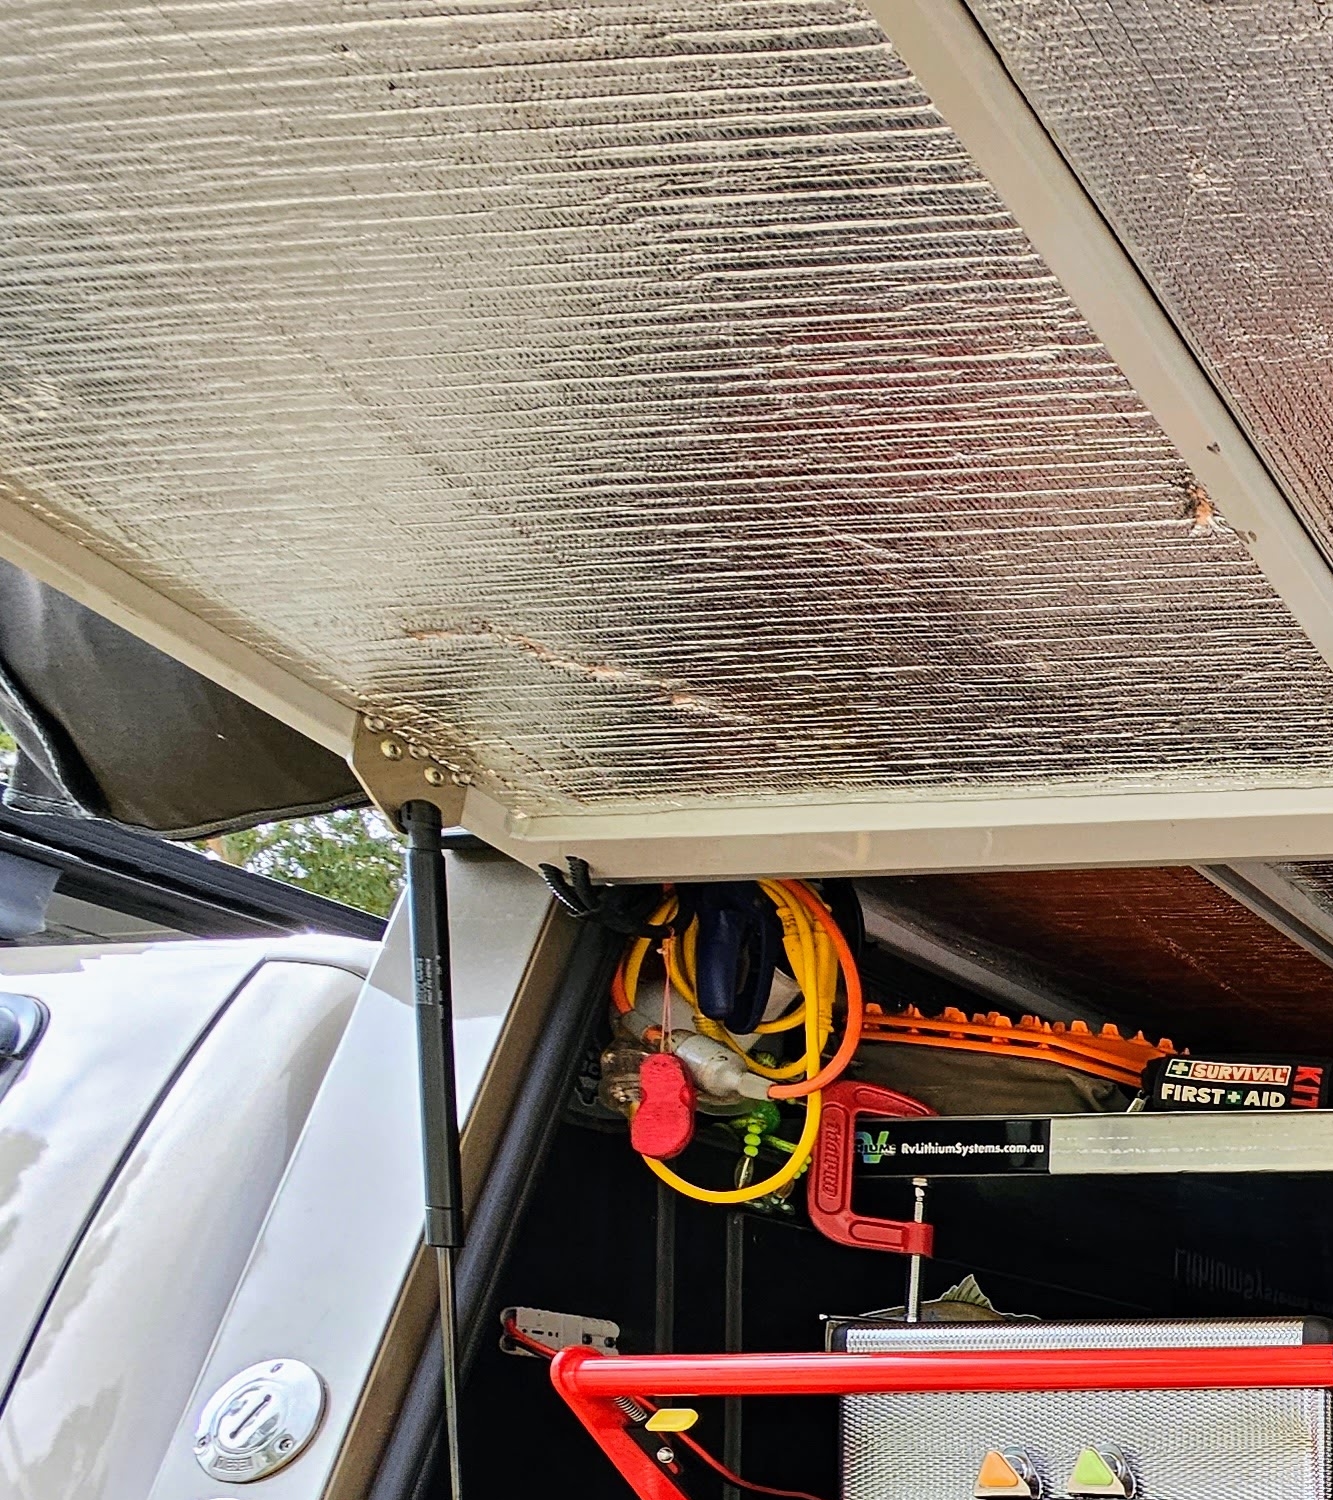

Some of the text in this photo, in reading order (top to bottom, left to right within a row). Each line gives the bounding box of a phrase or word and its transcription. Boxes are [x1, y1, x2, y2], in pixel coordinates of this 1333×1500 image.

[1194, 1064, 1288, 1083] SURVIVAL
[1161, 1083, 1286, 1108] FIRST AID
[1291, 1066, 1324, 1108] KIT
[901, 1141, 1045, 1157] RvLithiumSystems.com.au
